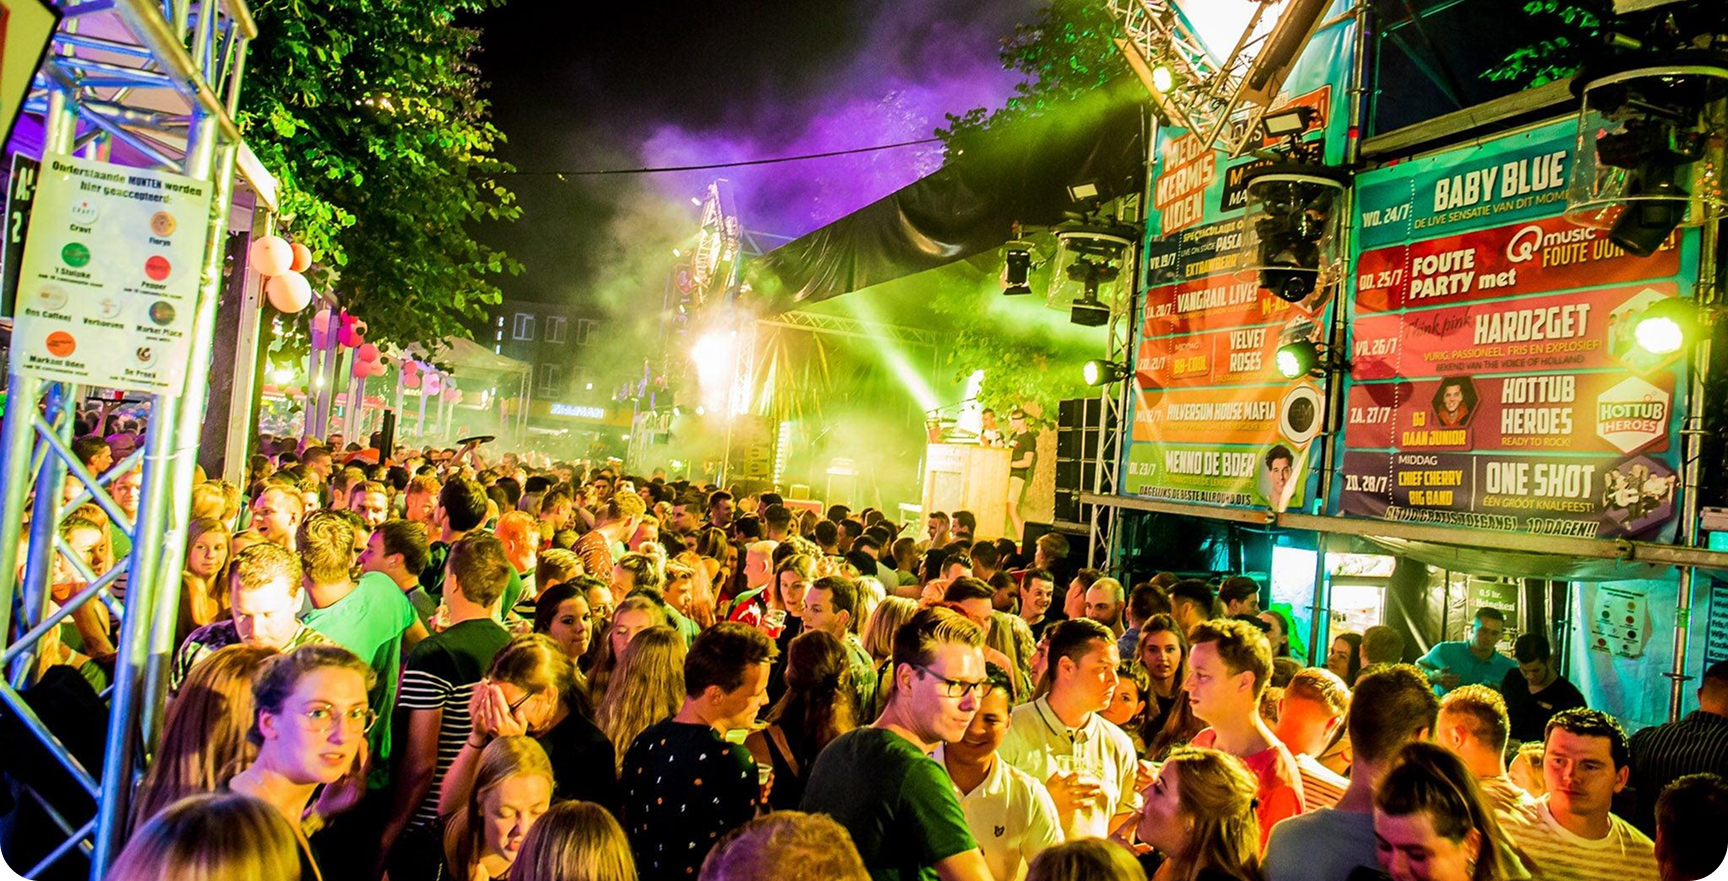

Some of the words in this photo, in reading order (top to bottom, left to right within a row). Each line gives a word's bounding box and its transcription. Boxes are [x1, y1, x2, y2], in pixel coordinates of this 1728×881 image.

[1164, 134, 1206, 172] MEG
[80, 181, 102, 193] hier
[128, 175, 162, 189] MUNTEN
[164, 182, 202, 197] worden
[1157, 152, 1214, 206] KERMIS
[1433, 166, 1498, 212] BABY
[1500, 150, 1566, 198] BLUE
[1164, 190, 1202, 234] UDEN
[1383, 203, 1410, 224] 24/7
[1414, 218, 1427, 229] DE
[1428, 215, 1447, 227] LIVE
[1448, 206, 1491, 224] SENSATIE
[1492, 201, 1514, 214] VAN
[1515, 197, 1532, 210] DIT
[1412, 248, 1475, 278] FOUTE
[1542, 242, 1589, 268] FOUTE
[1377, 269, 1403, 288] 25/7
[1410, 271, 1475, 300] PARTY
[1478, 268, 1516, 290] met
[1177, 286, 1227, 313] VANGRAIL
[1228, 283, 1258, 305] LIVE!
[1473, 303, 1590, 345] HARD2GET
[1230, 329, 1266, 350] VELVET
[1372, 337, 1398, 355] 26/7
[1508, 346, 1528, 357] FRIS
[1530, 344, 1545, 355] EN
[1546, 340, 1602, 353] EXPLOSIEF!
[1230, 351, 1262, 372] ROSES
[1466, 360, 1482, 370] VAN
[1484, 359, 1499, 369] THE
[1501, 357, 1525, 368] VOICE
[1527, 356, 1539, 367] OF
[1501, 375, 1575, 404] HOTTUB
[1167, 402, 1213, 422] HILVERSUM
[1214, 402, 1244, 421] HOUSE
[1245, 401, 1276, 421] MAFIA
[1366, 406, 1391, 424] 27/7
[1500, 407, 1573, 435] HEROES
[1601, 403, 1665, 421] HOTTUB
[1603, 420, 1657, 433] HEROES
[1402, 430, 1428, 446] DAAN
[1430, 429, 1466, 446] JUNIOR
[1501, 437, 1529, 447] READY
[1530, 436, 1541, 447] TO
[1166, 451, 1202, 475] MENNO
[1204, 451, 1220, 476] DE
[1222, 452, 1256, 479] BOER
[1398, 455, 1438, 466] MIDDAG
[1362, 475, 1388, 493] 28/7
[1398, 471, 1423, 486] CHIEF
[1424, 470, 1462, 486] CHERRY
[1486, 461, 1529, 494] ONE
[1534, 463, 1595, 499] SHOT
[1139, 485, 1171, 499] DAGELIJKS
[1172, 488, 1180, 499] DE
[1180, 489, 1200, 502] BESTE
[1409, 490, 1425, 506] BIG
[1425, 490, 1453, 506] BAND
[1536, 499, 1595, 514] KNALFEEST!
[1421, 508, 1458, 525] GRATIS
[1459, 512, 1517, 532] TOEGANG!
[1526, 517, 1542, 533] 10
[1541, 519, 1599, 540] DAGEN!!
